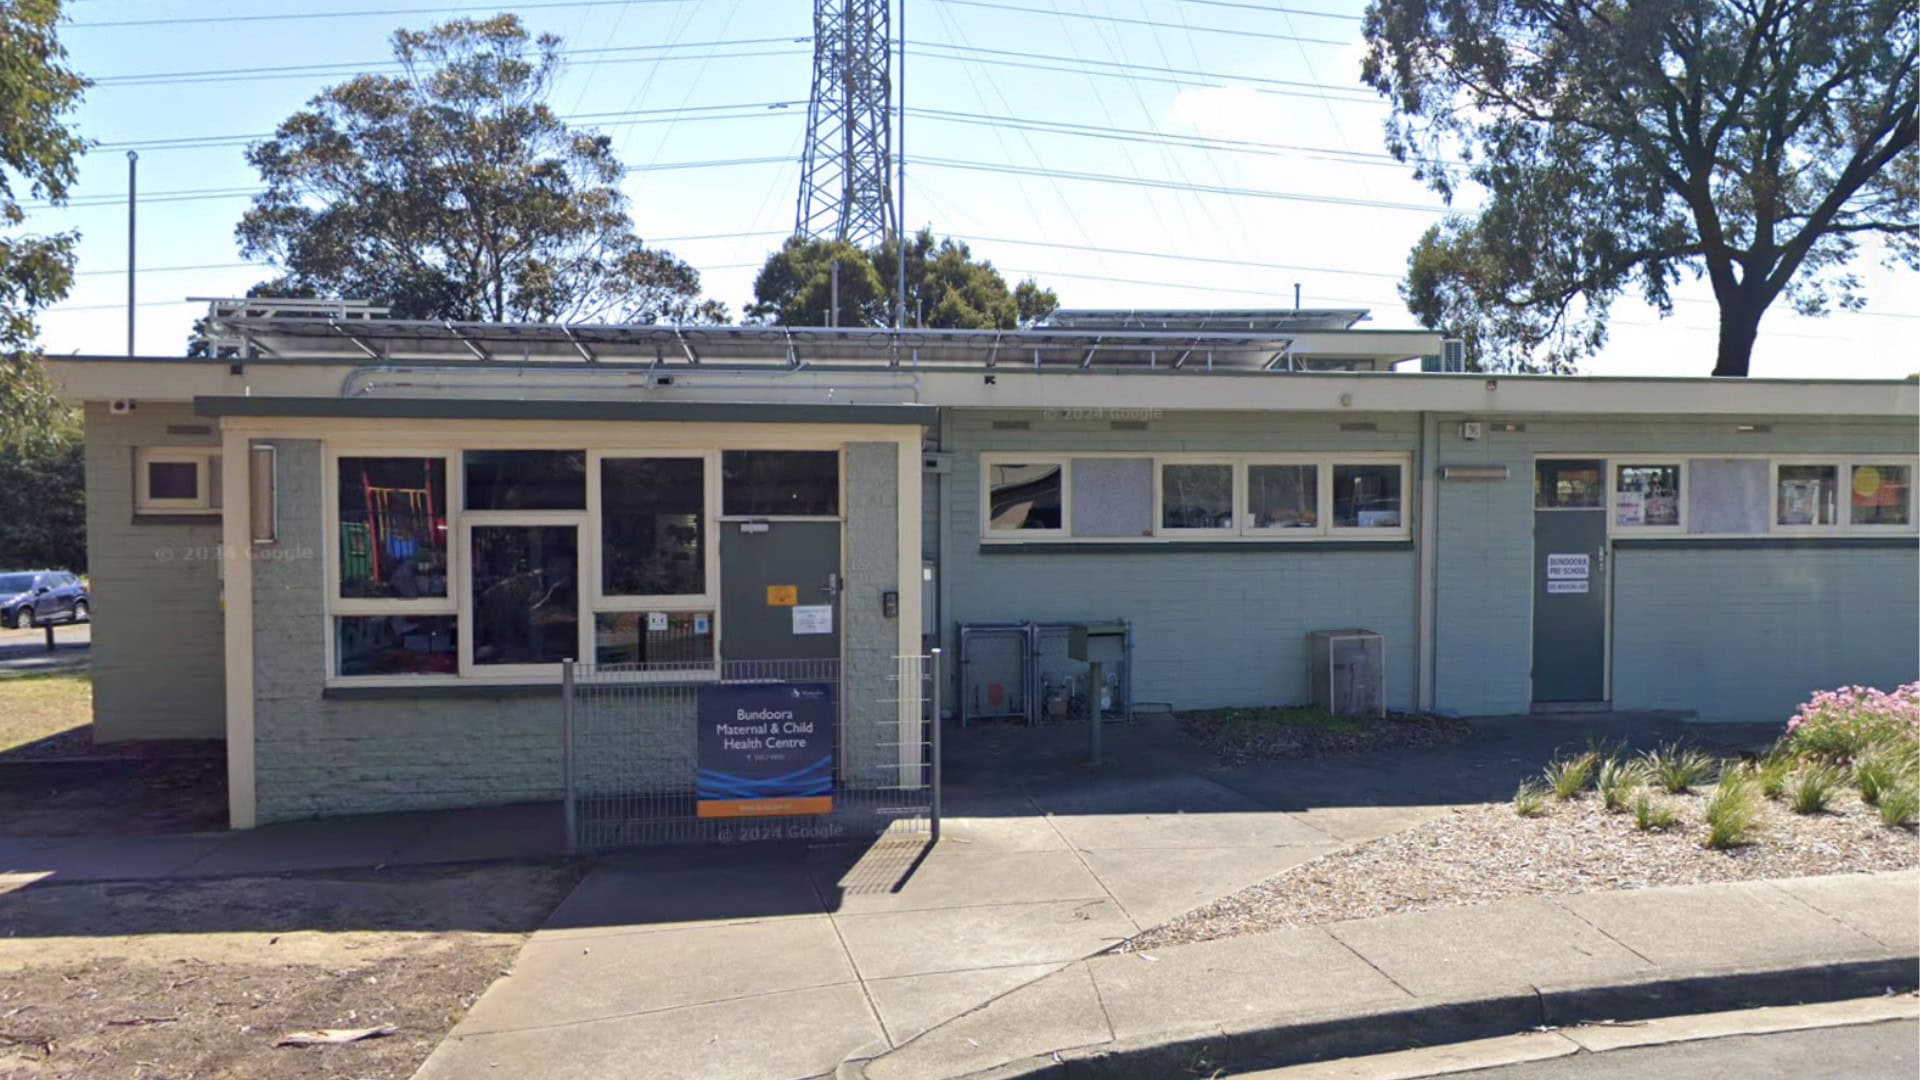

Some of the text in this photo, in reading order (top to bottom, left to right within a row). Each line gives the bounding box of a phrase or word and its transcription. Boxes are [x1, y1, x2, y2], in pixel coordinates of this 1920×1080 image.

[737, 708, 793, 721] Bundoora
[716, 722, 813, 735] Maternal & Child
[724, 737, 807, 750] Health Centre
